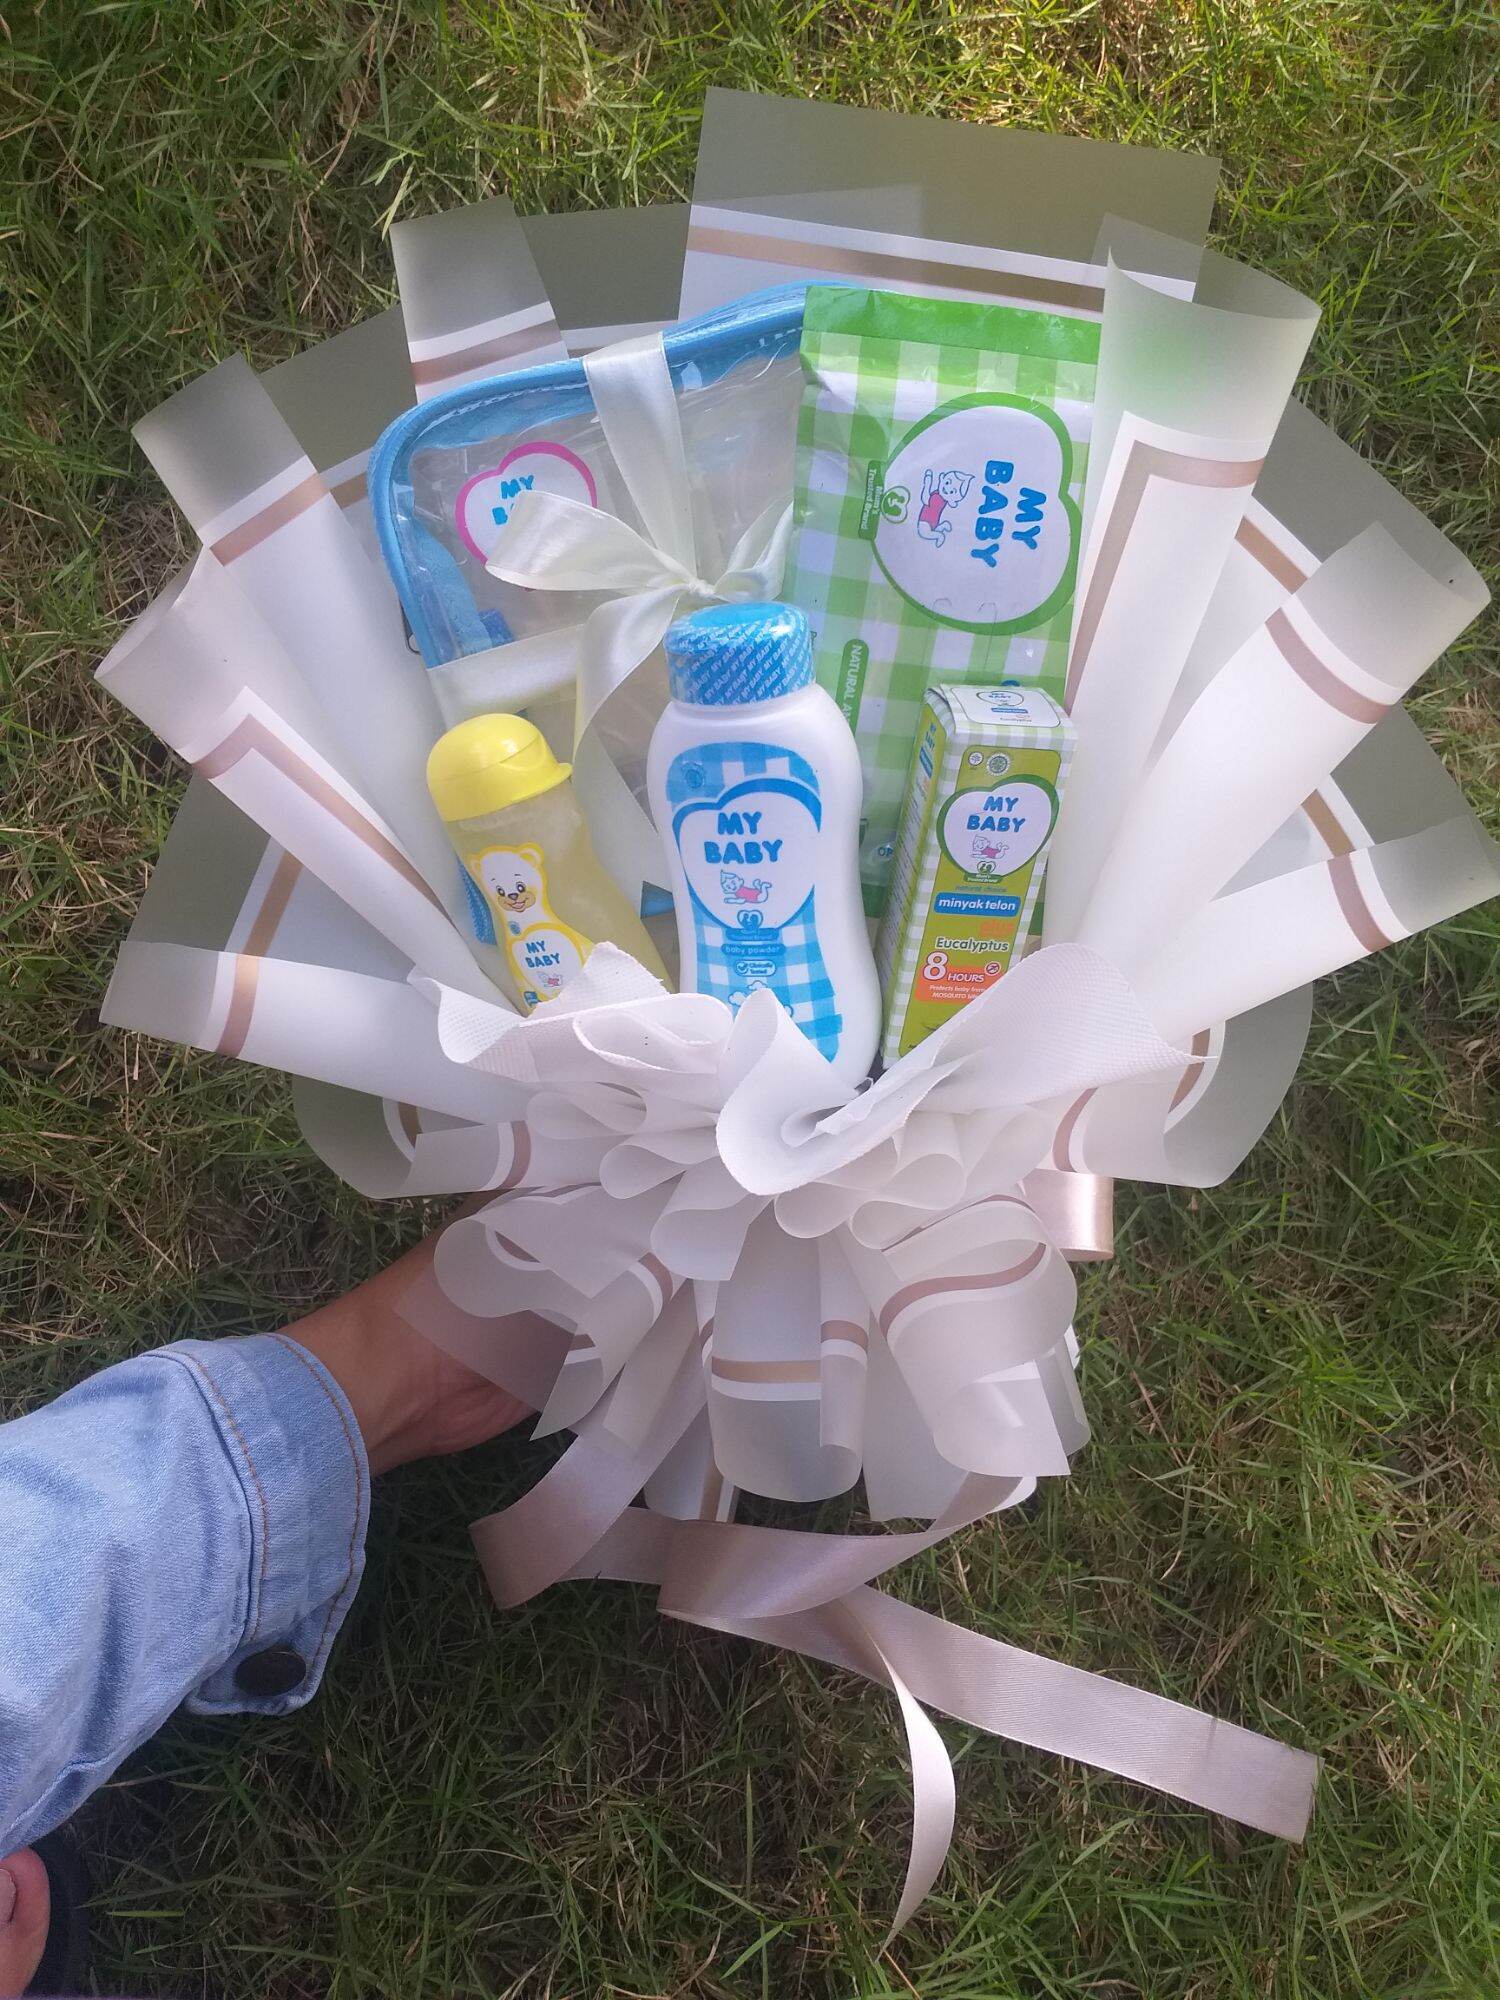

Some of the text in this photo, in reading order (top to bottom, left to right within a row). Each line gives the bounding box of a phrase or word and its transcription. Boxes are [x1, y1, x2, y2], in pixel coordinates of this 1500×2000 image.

[500, 474, 534, 499] MY
[860, 468, 877, 530] Trusted Brand
[970, 460, 1014, 568] BABY
[1011, 487, 1047, 550] MY
[843, 645, 863, 700] NATURAL
[984, 796, 1019, 812] MY
[717, 811, 762, 835] MY
[967, 815, 1026, 833] BABY
[704, 839, 783, 864] BABY
[938, 898, 1016, 911] minyak telon
[525, 940, 546, 954] MY
[725, 945, 780, 956] baby powder
[936, 936, 1009, 953] Eucalyptus
[525, 952, 560, 968] BABY
[922, 951, 985, 983] 8 HOURS
